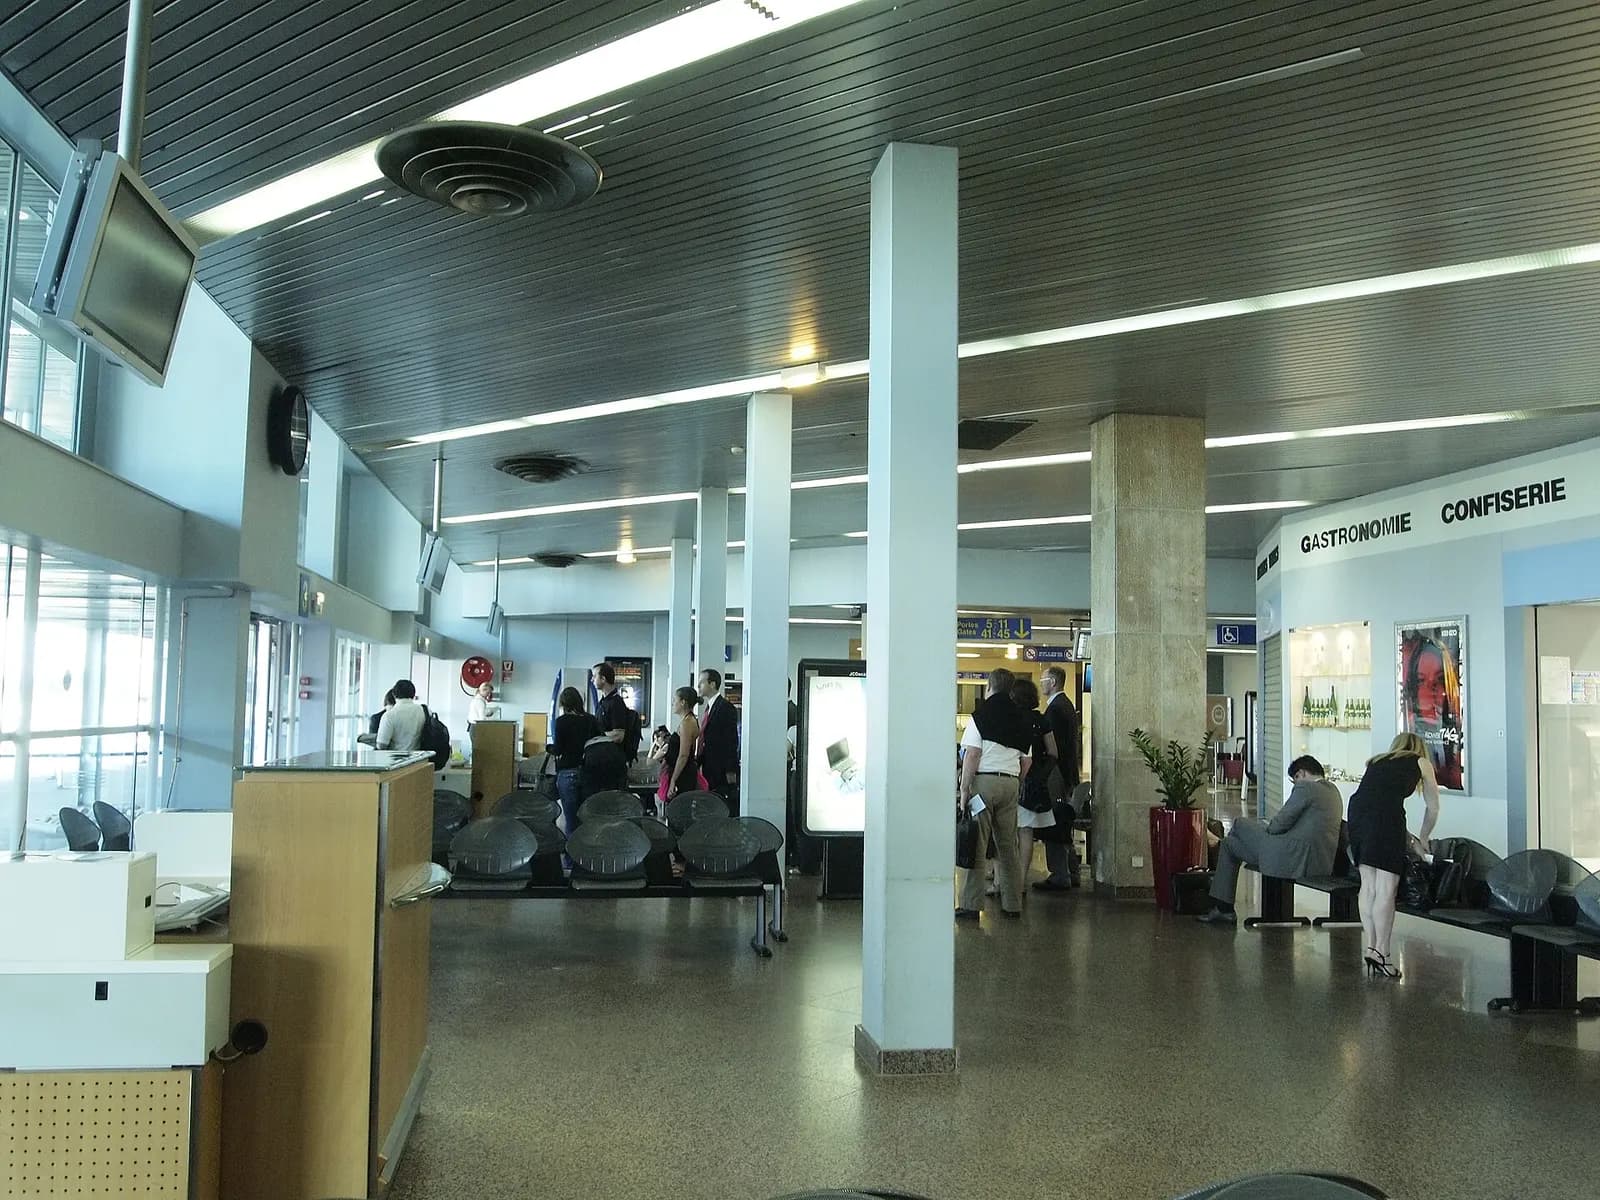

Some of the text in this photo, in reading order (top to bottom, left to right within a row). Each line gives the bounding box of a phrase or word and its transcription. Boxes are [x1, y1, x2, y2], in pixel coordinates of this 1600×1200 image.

[1301, 477, 1566, 553] GASTRONOMIE CONFISERIE
[986, 619, 993, 629] 5
[981, 629, 992, 639] 41
[997, 629, 1011, 639] 45
